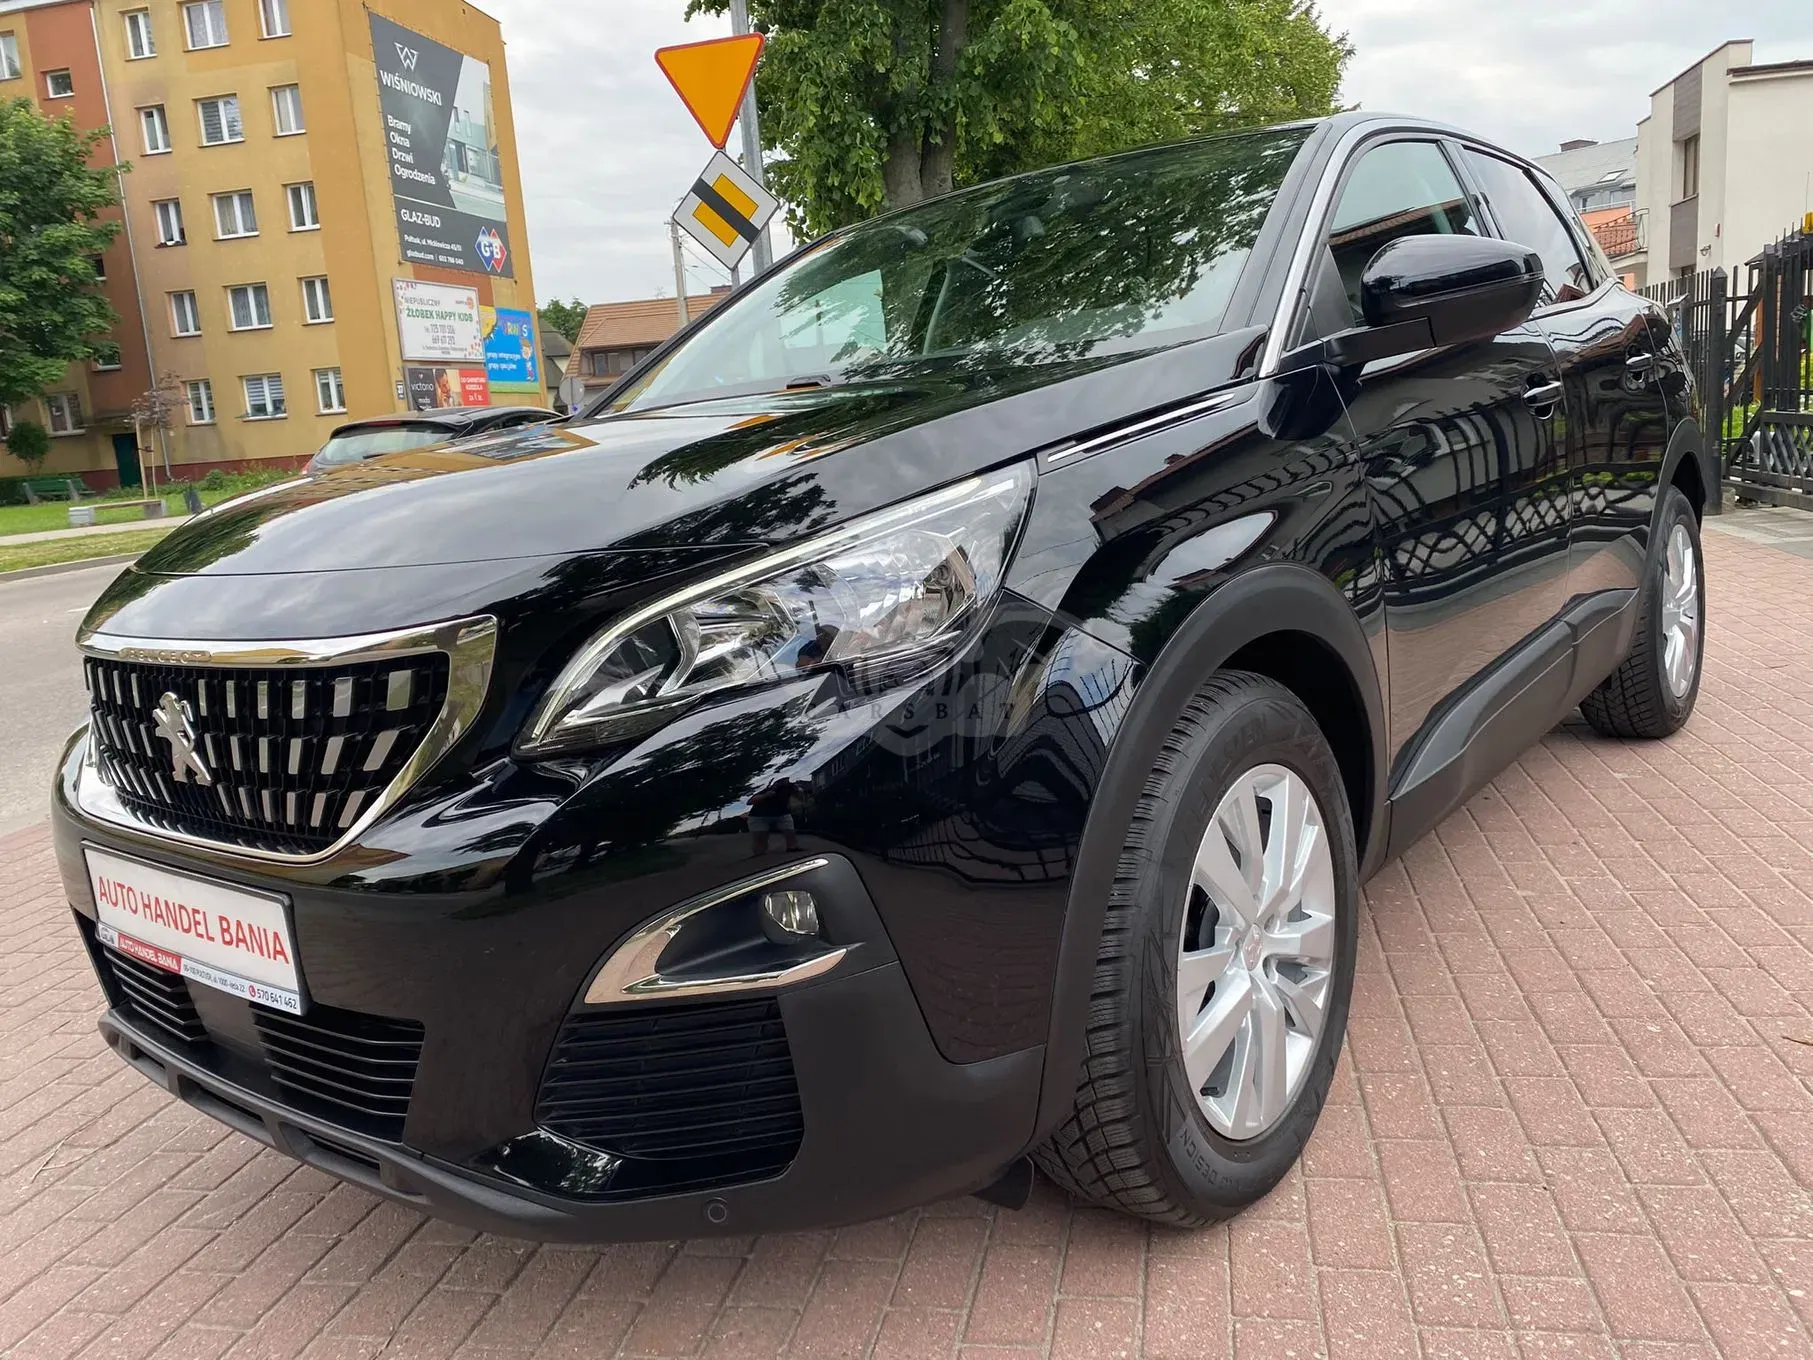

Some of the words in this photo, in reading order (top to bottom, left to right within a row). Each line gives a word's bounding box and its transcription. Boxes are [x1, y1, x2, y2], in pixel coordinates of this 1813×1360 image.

[380, 70, 442, 106] WIŚNIOWSKI
[388, 114, 411, 134] Bramy
[390, 132, 410, 148] Okna
[392, 148, 414, 164] Drzwi
[394, 164, 436, 185] Ogrodzenia
[400, 209, 440, 228] GLAZ-BUD
[435, 310, 456, 322] HAPPY
[98, 876, 138, 915] AUTO
[140, 891, 215, 942] HANDEL
[218, 915, 289, 964] BANIA
[120, 937, 134, 952] AUTO
[134, 945, 158, 962] HANDEL
[158, 953, 178, 970] BANIA
[257, 988, 270, 1001] 570
[270, 993, 282, 1004] 641
[284, 996, 297, 1010] 462
